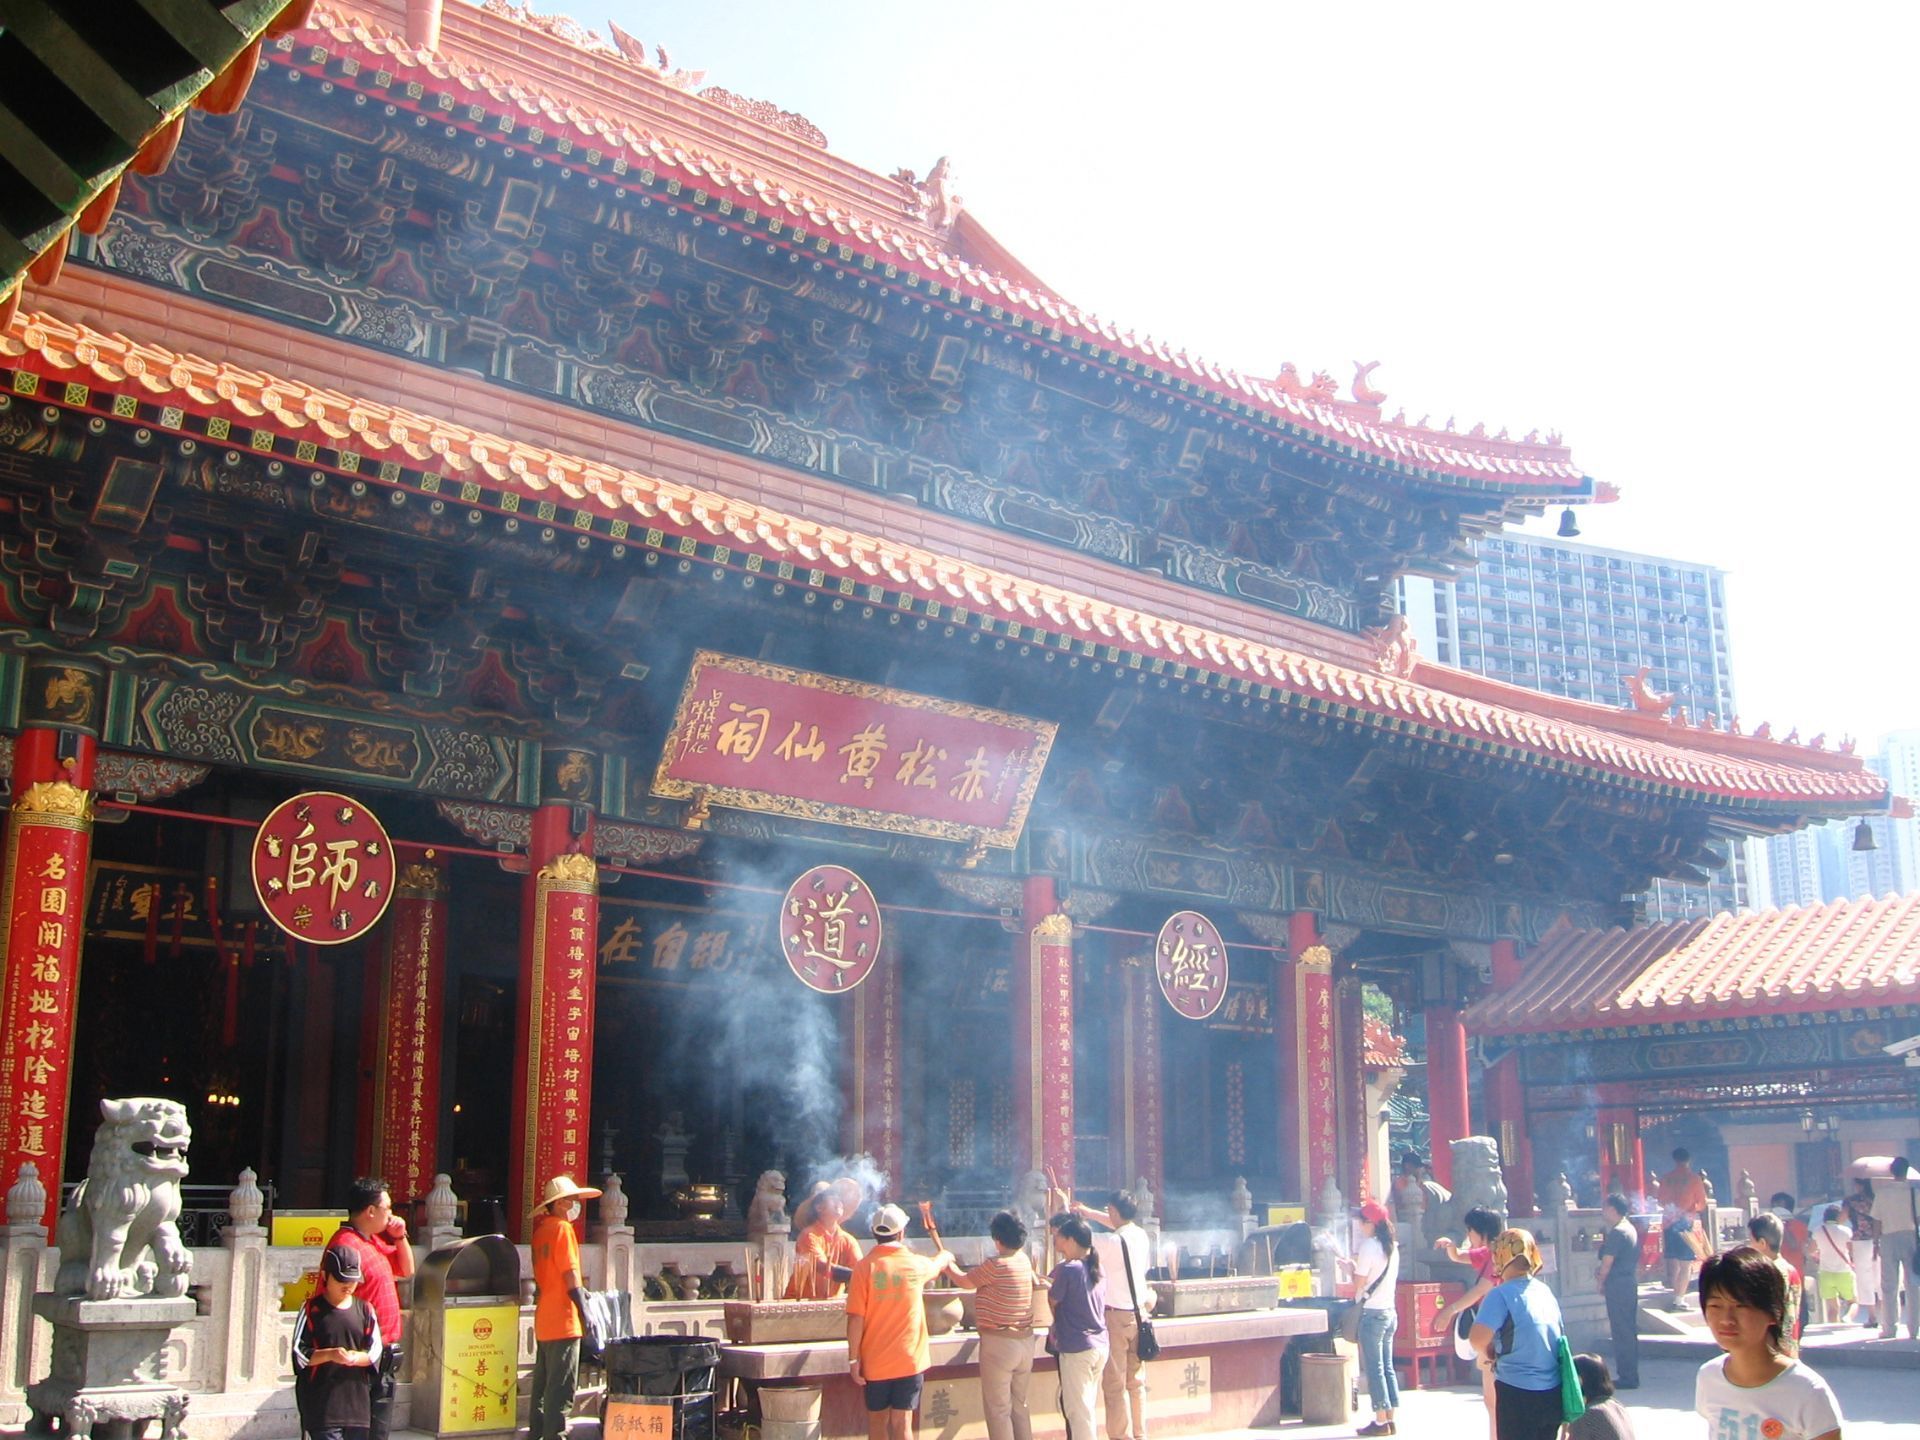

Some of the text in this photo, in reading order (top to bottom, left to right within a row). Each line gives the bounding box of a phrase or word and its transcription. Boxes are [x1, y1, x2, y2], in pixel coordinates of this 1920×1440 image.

[286, 822, 359, 911] 師
[801, 891, 857, 970] 道
[1171, 935, 1211, 991] 經
[1180, 1362, 1207, 1398] 普
[924, 1388, 959, 1429] 善
